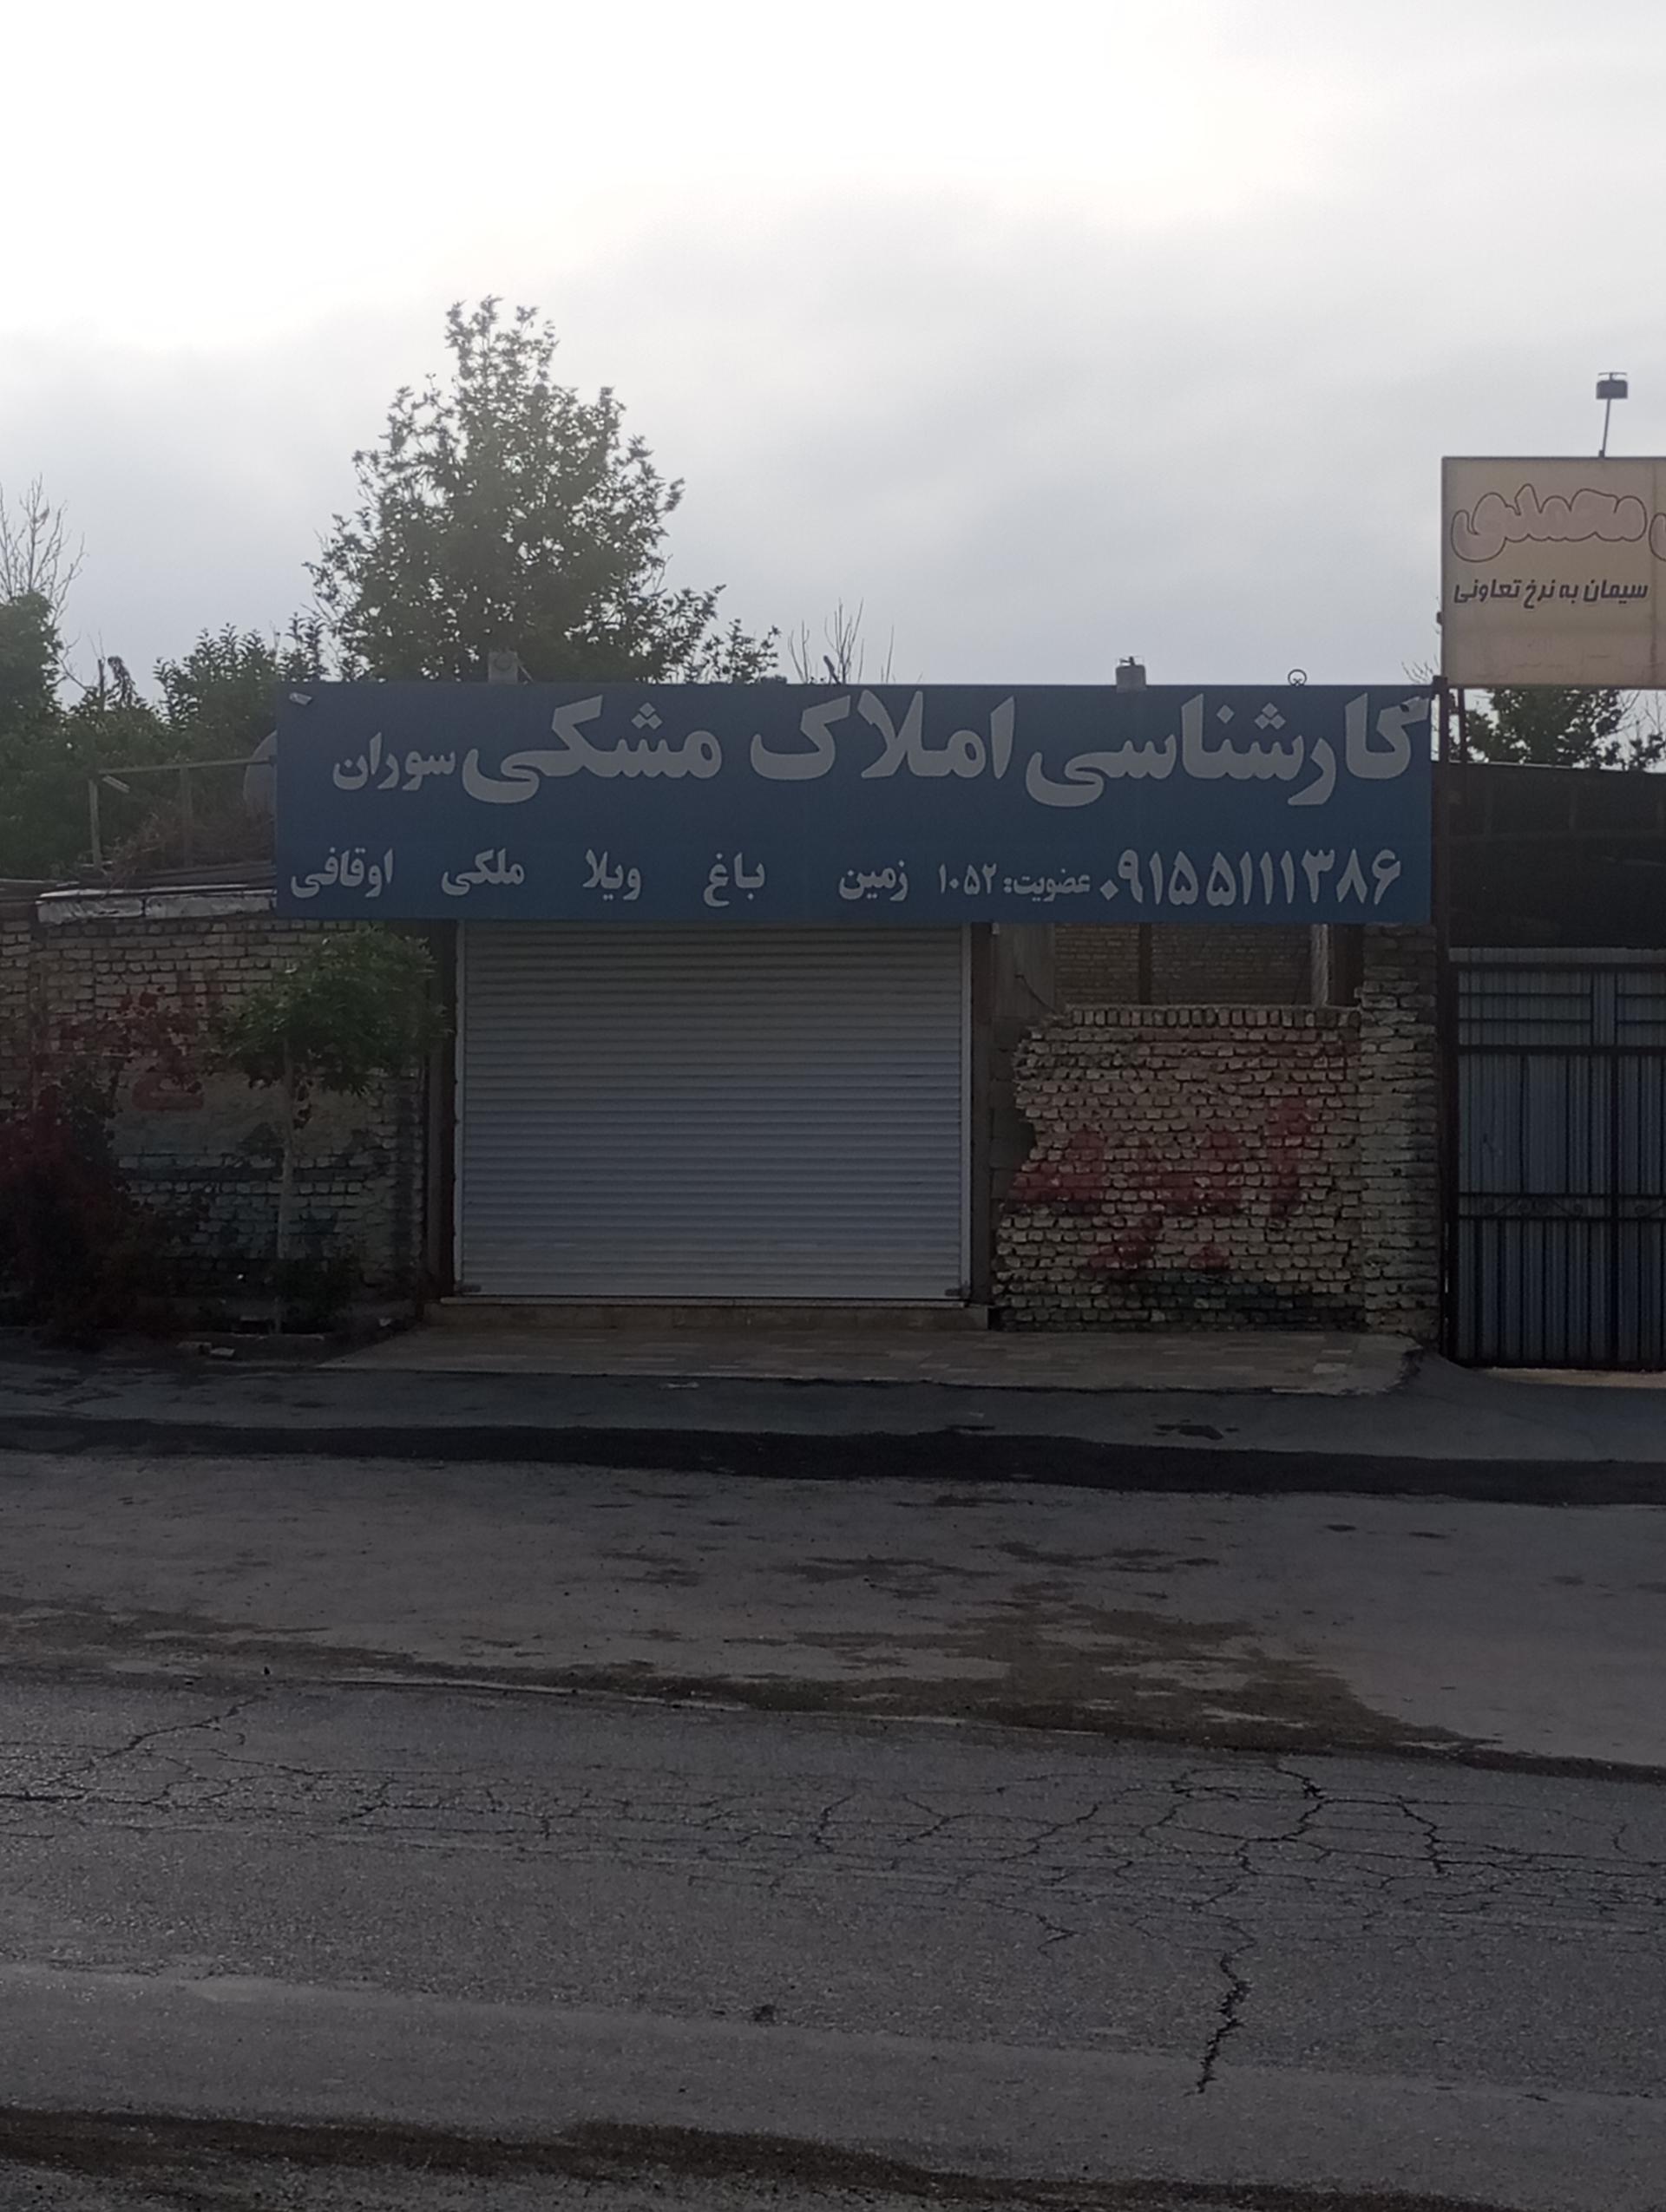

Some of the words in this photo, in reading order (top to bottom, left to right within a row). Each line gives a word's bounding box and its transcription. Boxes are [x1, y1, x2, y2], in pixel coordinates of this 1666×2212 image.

[1453, 579, 1523, 605] تعاونی
[1523, 579, 1557, 610] نرخ
[1558, 584, 1580, 605] به
[1583, 579, 1649, 605] سیمان
[462, 695, 722, 803] مشکی
[751, 689, 1014, 780] املاک
[1026, 693, 1429, 807] کارشناسی
[332, 732, 456, 790] سوران
[291, 847, 393, 899] اوقافی
[441, 847, 525, 896] ملکی
[582, 848, 641, 900] ویلا
[703, 852, 765, 907] باغ
[838, 860, 908, 901] زمین
[938, 862, 997, 895] ۱۰۵۲
[1003, 867, 1091, 902] عضویت:
[1099, 847, 1401, 906] ۰۹۱۵۵۱۱۱۳۸۶
